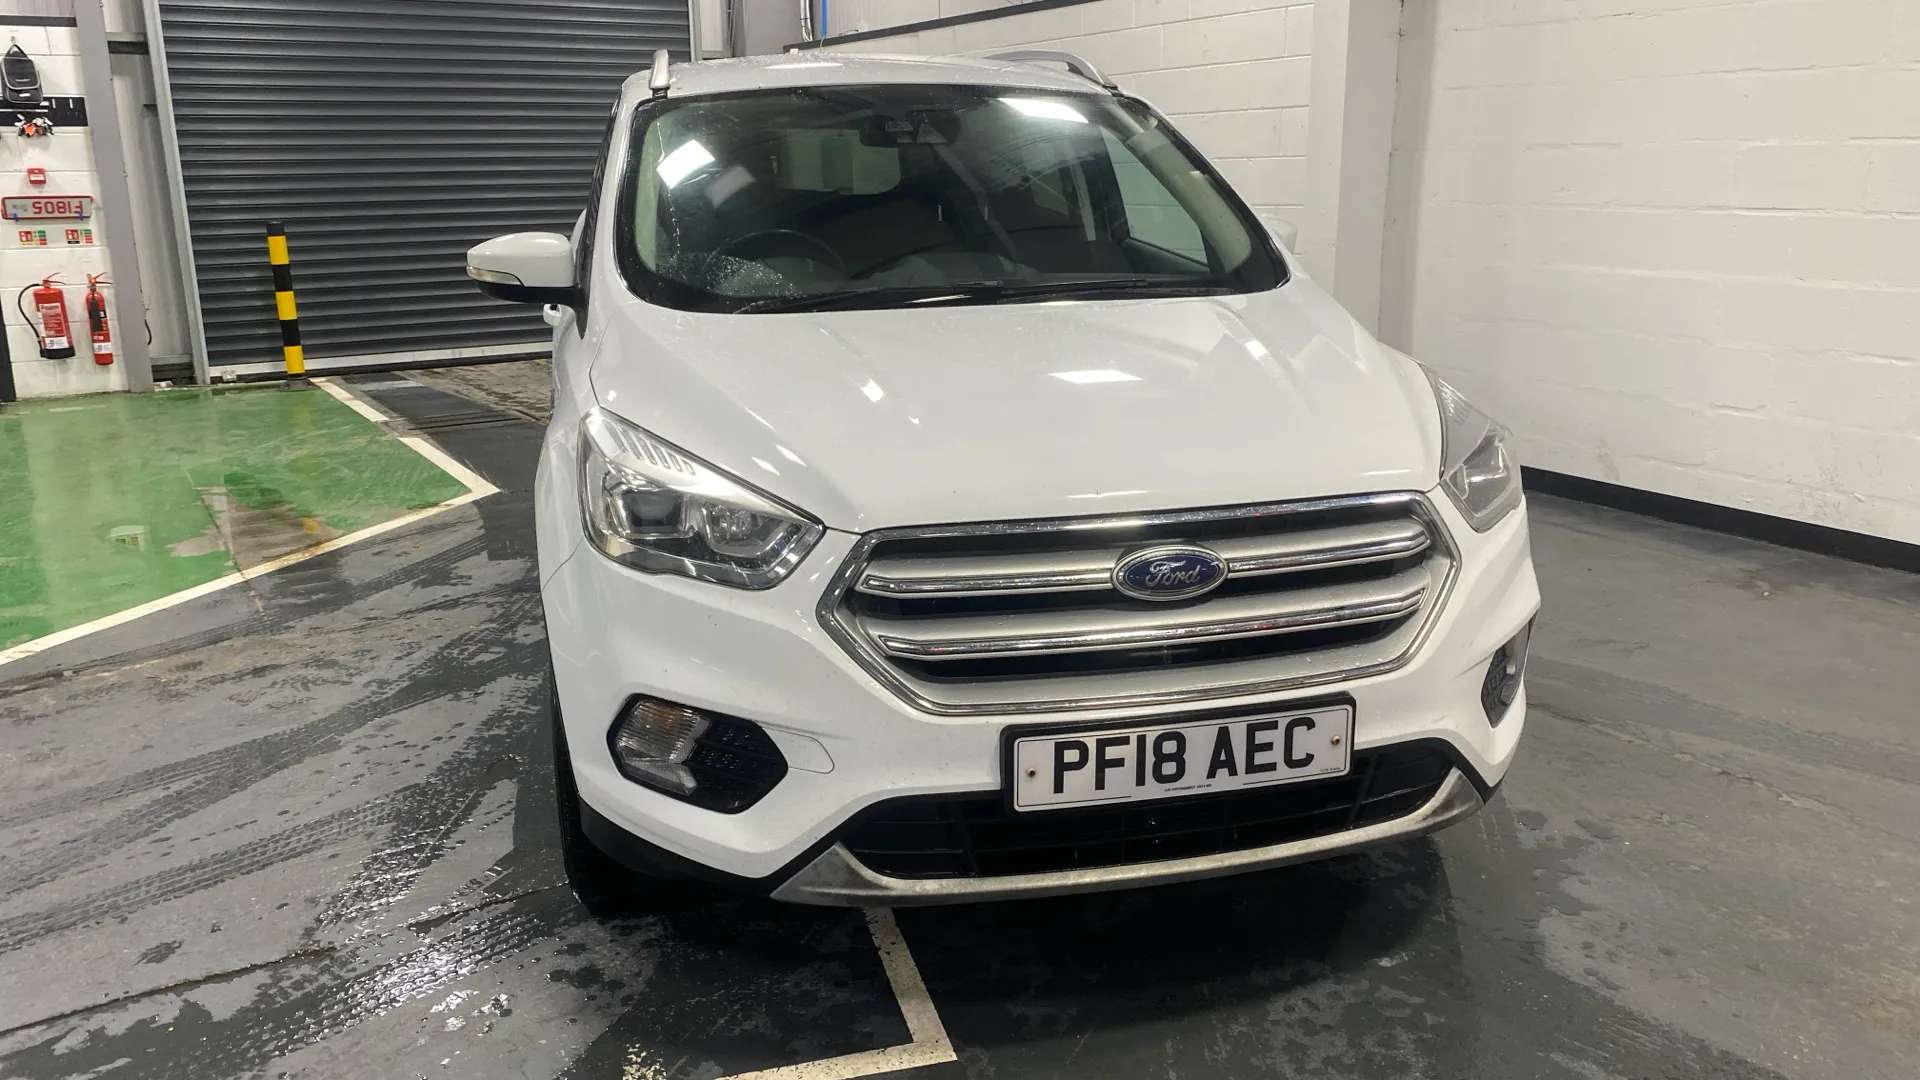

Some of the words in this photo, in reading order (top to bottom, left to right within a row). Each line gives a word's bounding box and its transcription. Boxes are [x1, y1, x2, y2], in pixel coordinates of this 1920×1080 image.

[1145, 560, 1201, 586] Ford
[1053, 731, 1187, 794] PF18
[1206, 717, 1316, 779] AEC
